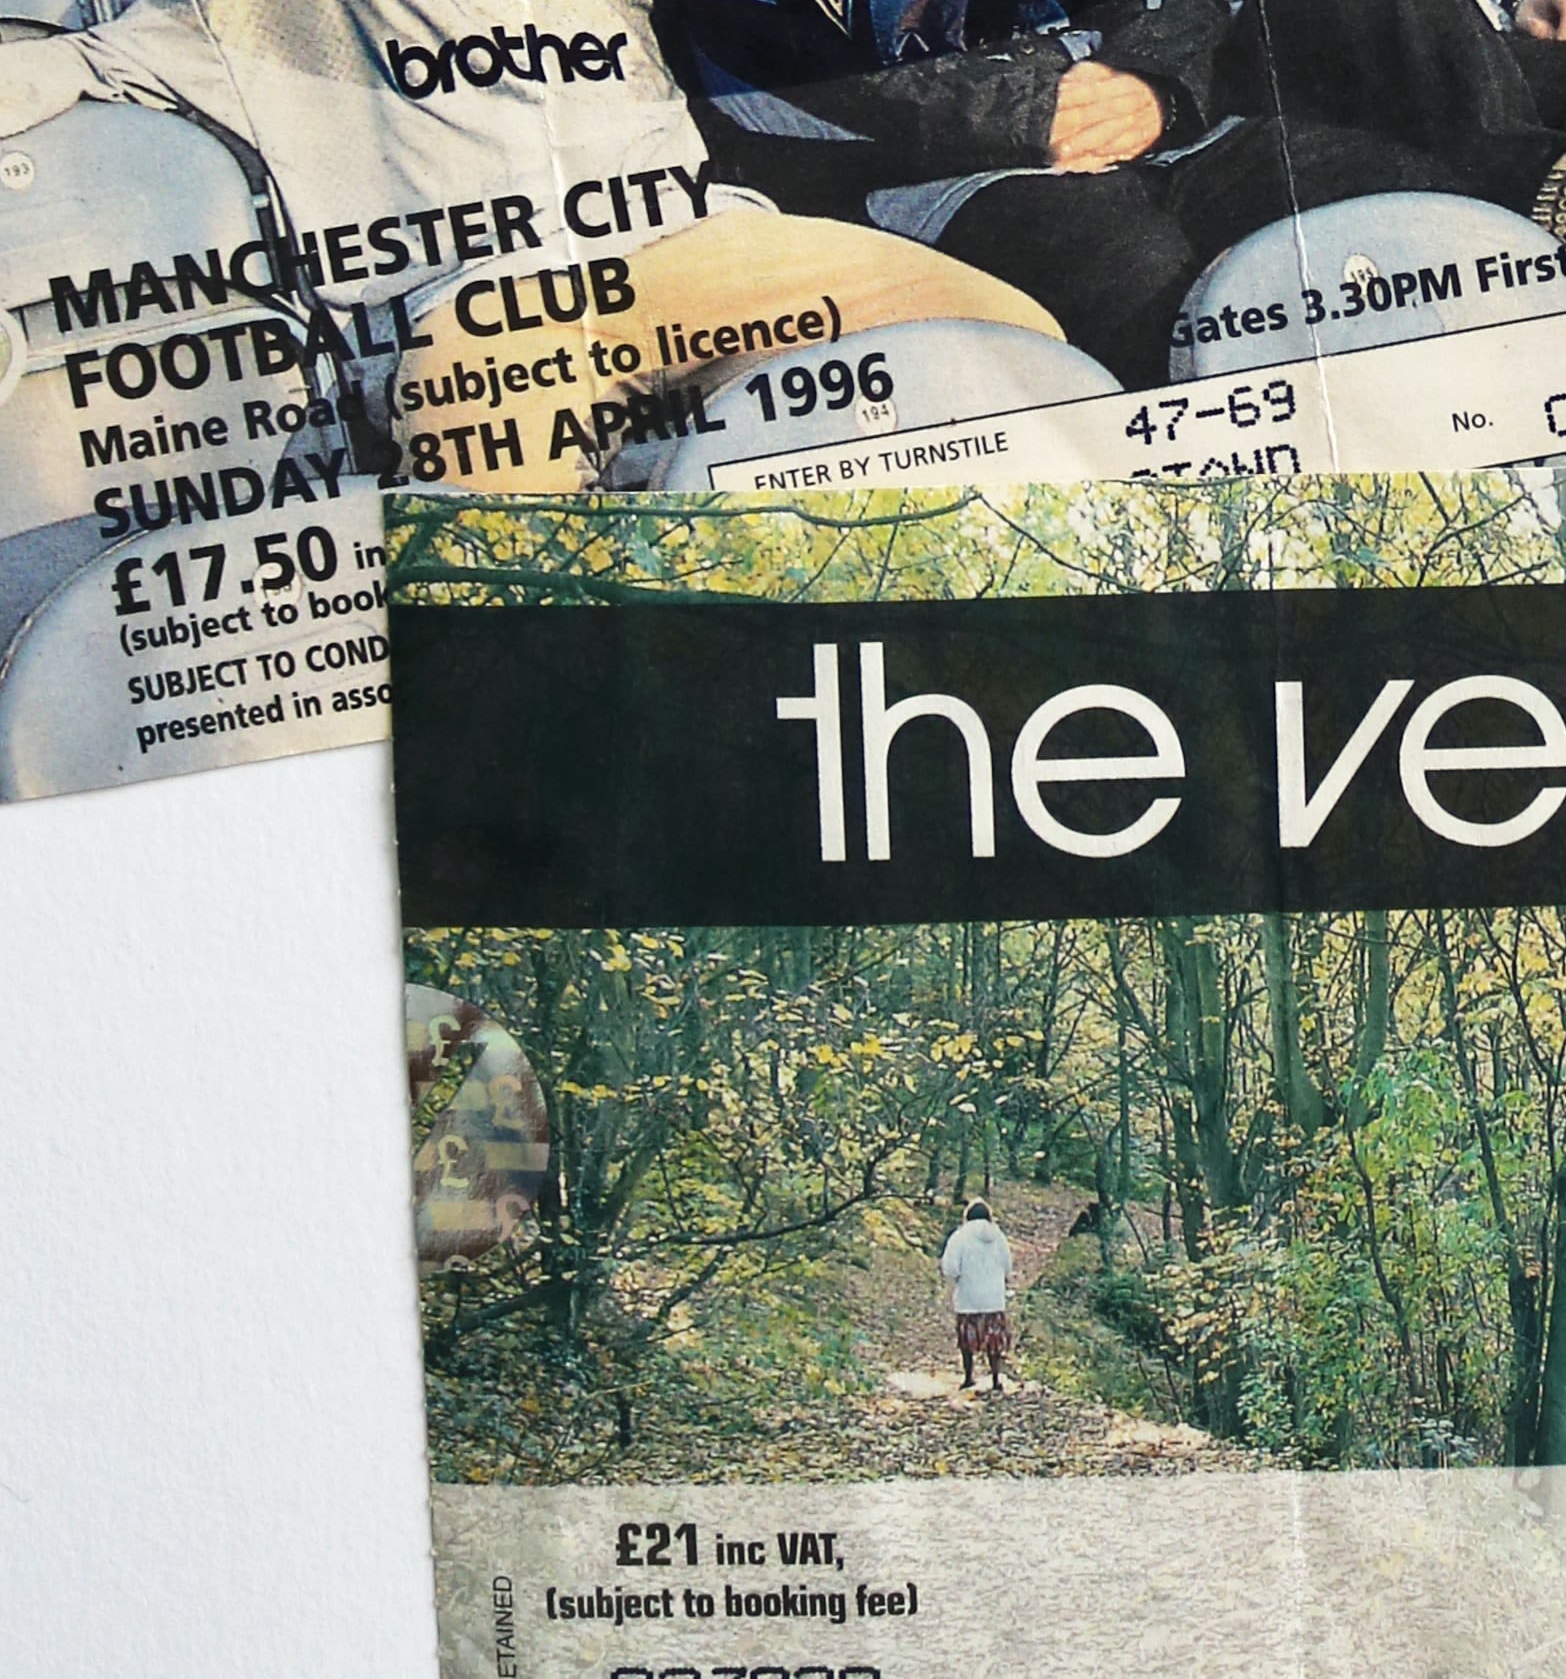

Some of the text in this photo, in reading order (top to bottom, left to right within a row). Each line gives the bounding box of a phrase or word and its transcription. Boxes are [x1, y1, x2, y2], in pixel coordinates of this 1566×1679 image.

[386, 23, 627, 99] brother
[48, 160, 716, 333] MANCHESTER CITY
[65, 257, 637, 409] FOOTBALL CLUB
[1169, 301, 1288, 349] Gates
[1302, 264, 1464, 325] 3.30PM
[79, 295, 842, 467] Maine Road (subject to licence)
[1453, 412, 1494, 432] No.
[94, 352, 895, 539] SUNDAY 28TH APRIL 1996
[879, 380, 1296, 473] TURNSTILE 47-69
[111, 526, 338, 616] £17.50
[120, 601, 298, 656] (subject to
[128, 659, 249, 705] SUBJECT
[136, 694, 285, 753] presented
[776, 641, 1186, 862] the
[615, 1523, 843, 1570] £21 inc VAT,
[546, 1583, 918, 1625] (subject to booking fee)
